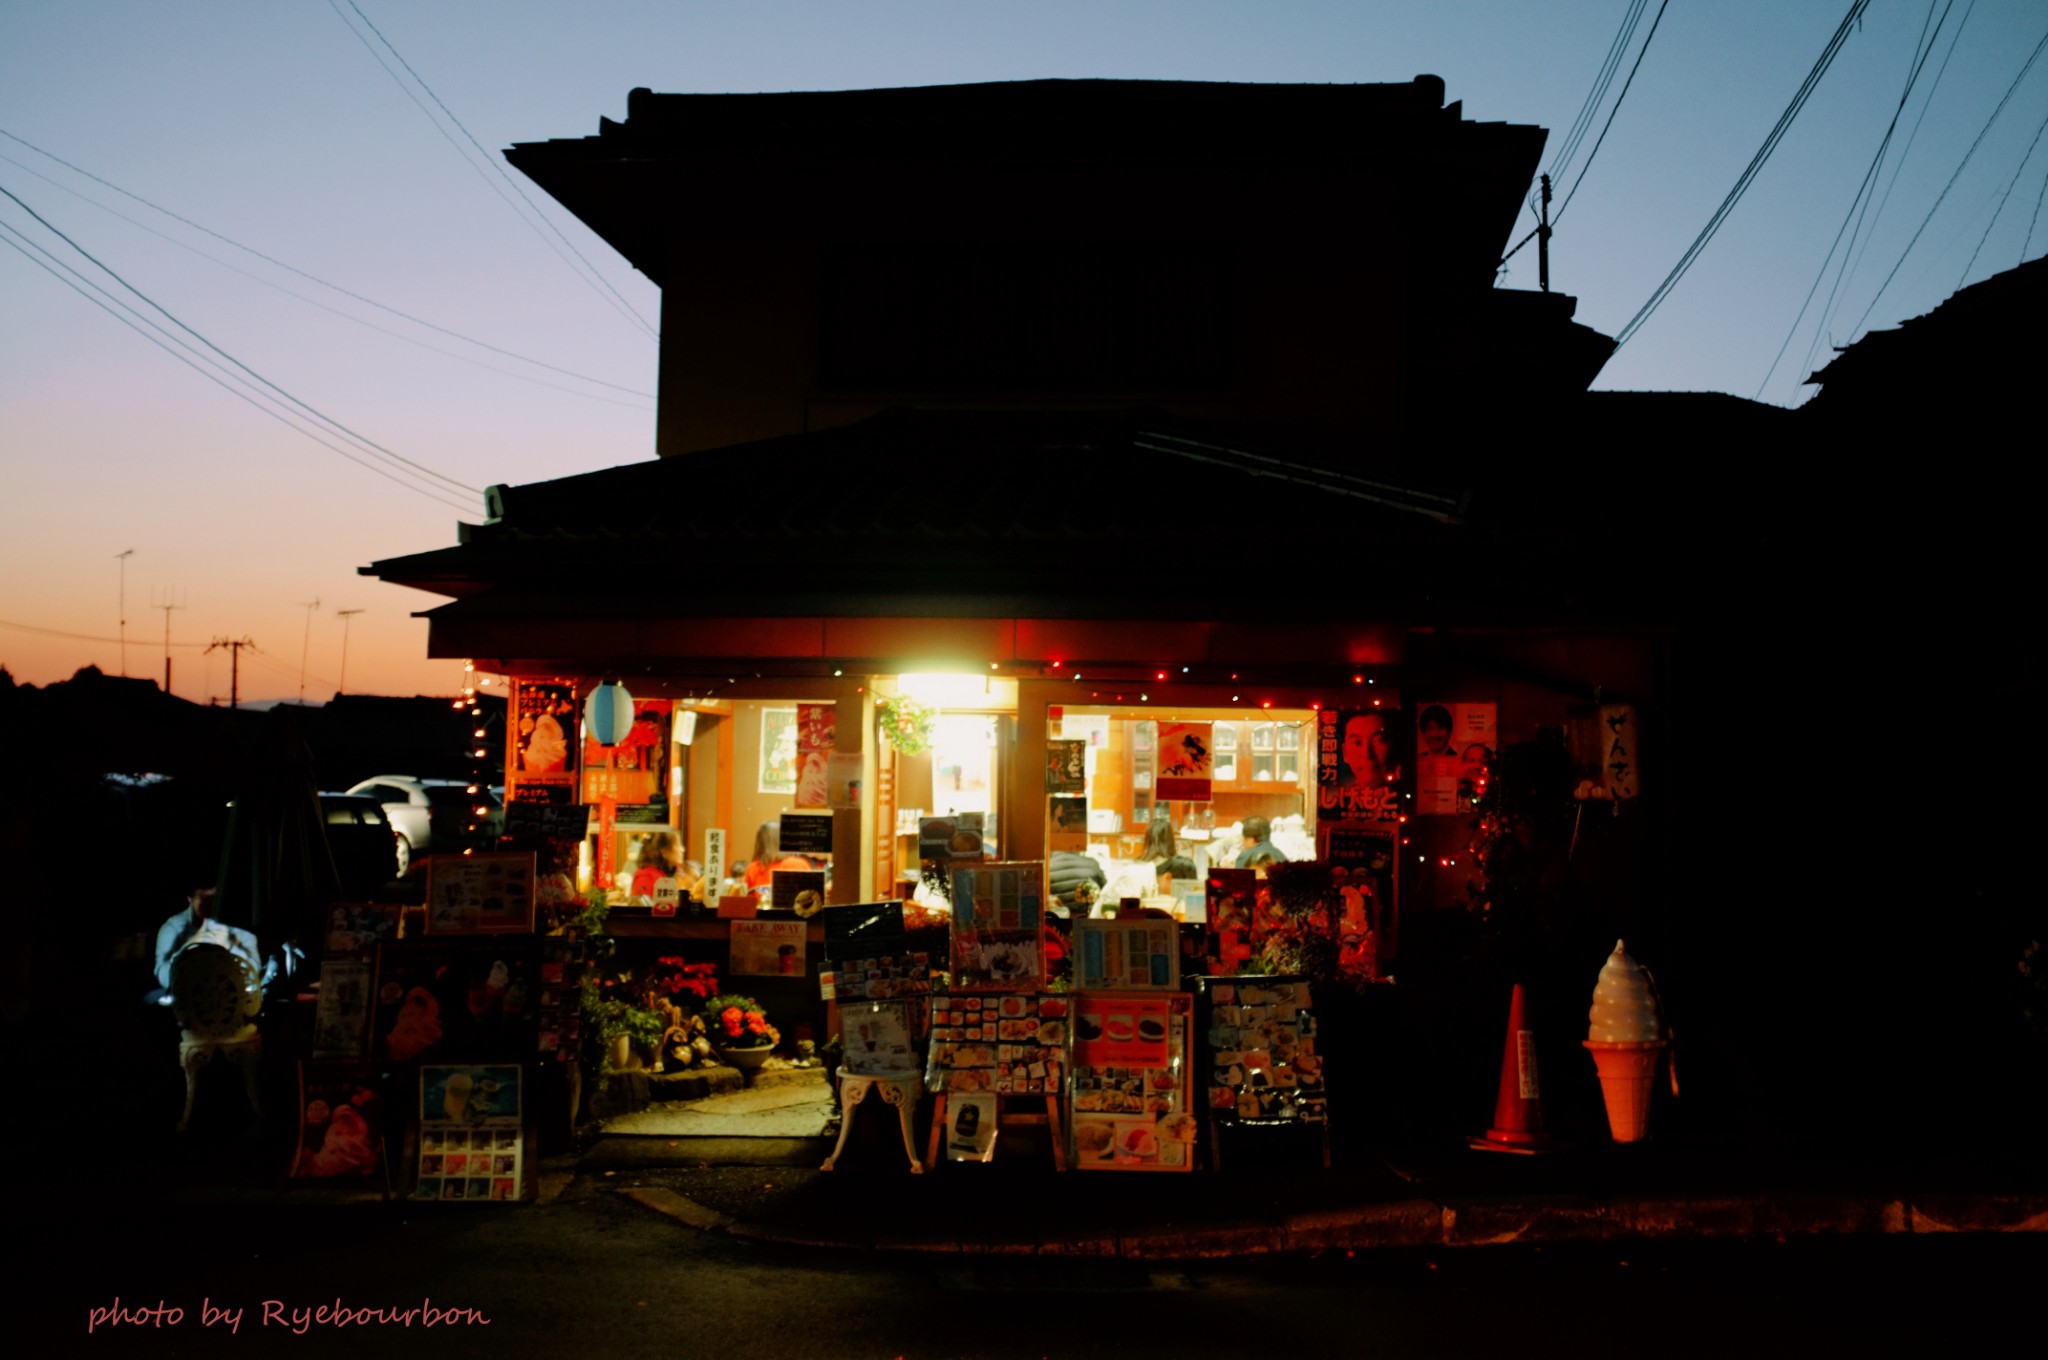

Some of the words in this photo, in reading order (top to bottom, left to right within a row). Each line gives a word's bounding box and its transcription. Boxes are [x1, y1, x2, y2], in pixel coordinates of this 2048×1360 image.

[1320, 710, 1339, 782] 若き即戦力
[1607, 712, 1632, 800] ぜんざい
[1319, 784, 1399, 810] しげもと
[708, 831, 721, 898] 軽食あります
[736, 922, 765, 935] TAKE
[771, 923, 801, 935] AWAY
